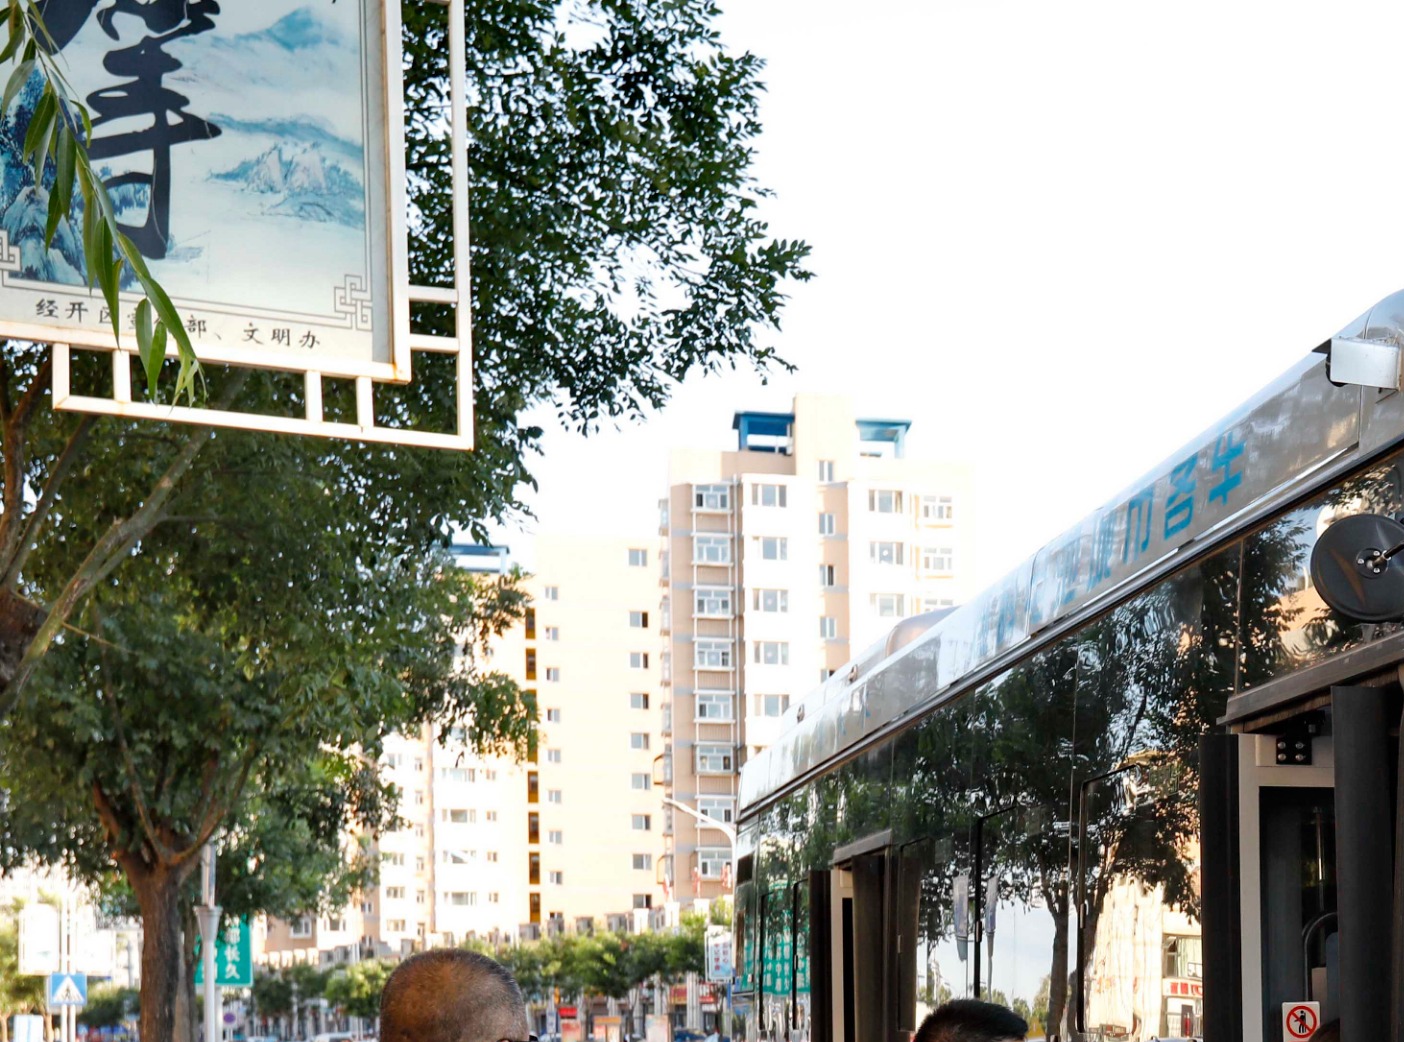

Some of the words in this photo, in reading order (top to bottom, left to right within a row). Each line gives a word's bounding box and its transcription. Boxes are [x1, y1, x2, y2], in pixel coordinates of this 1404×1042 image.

[35, 297, 321, 350] 经开区部、文明办
